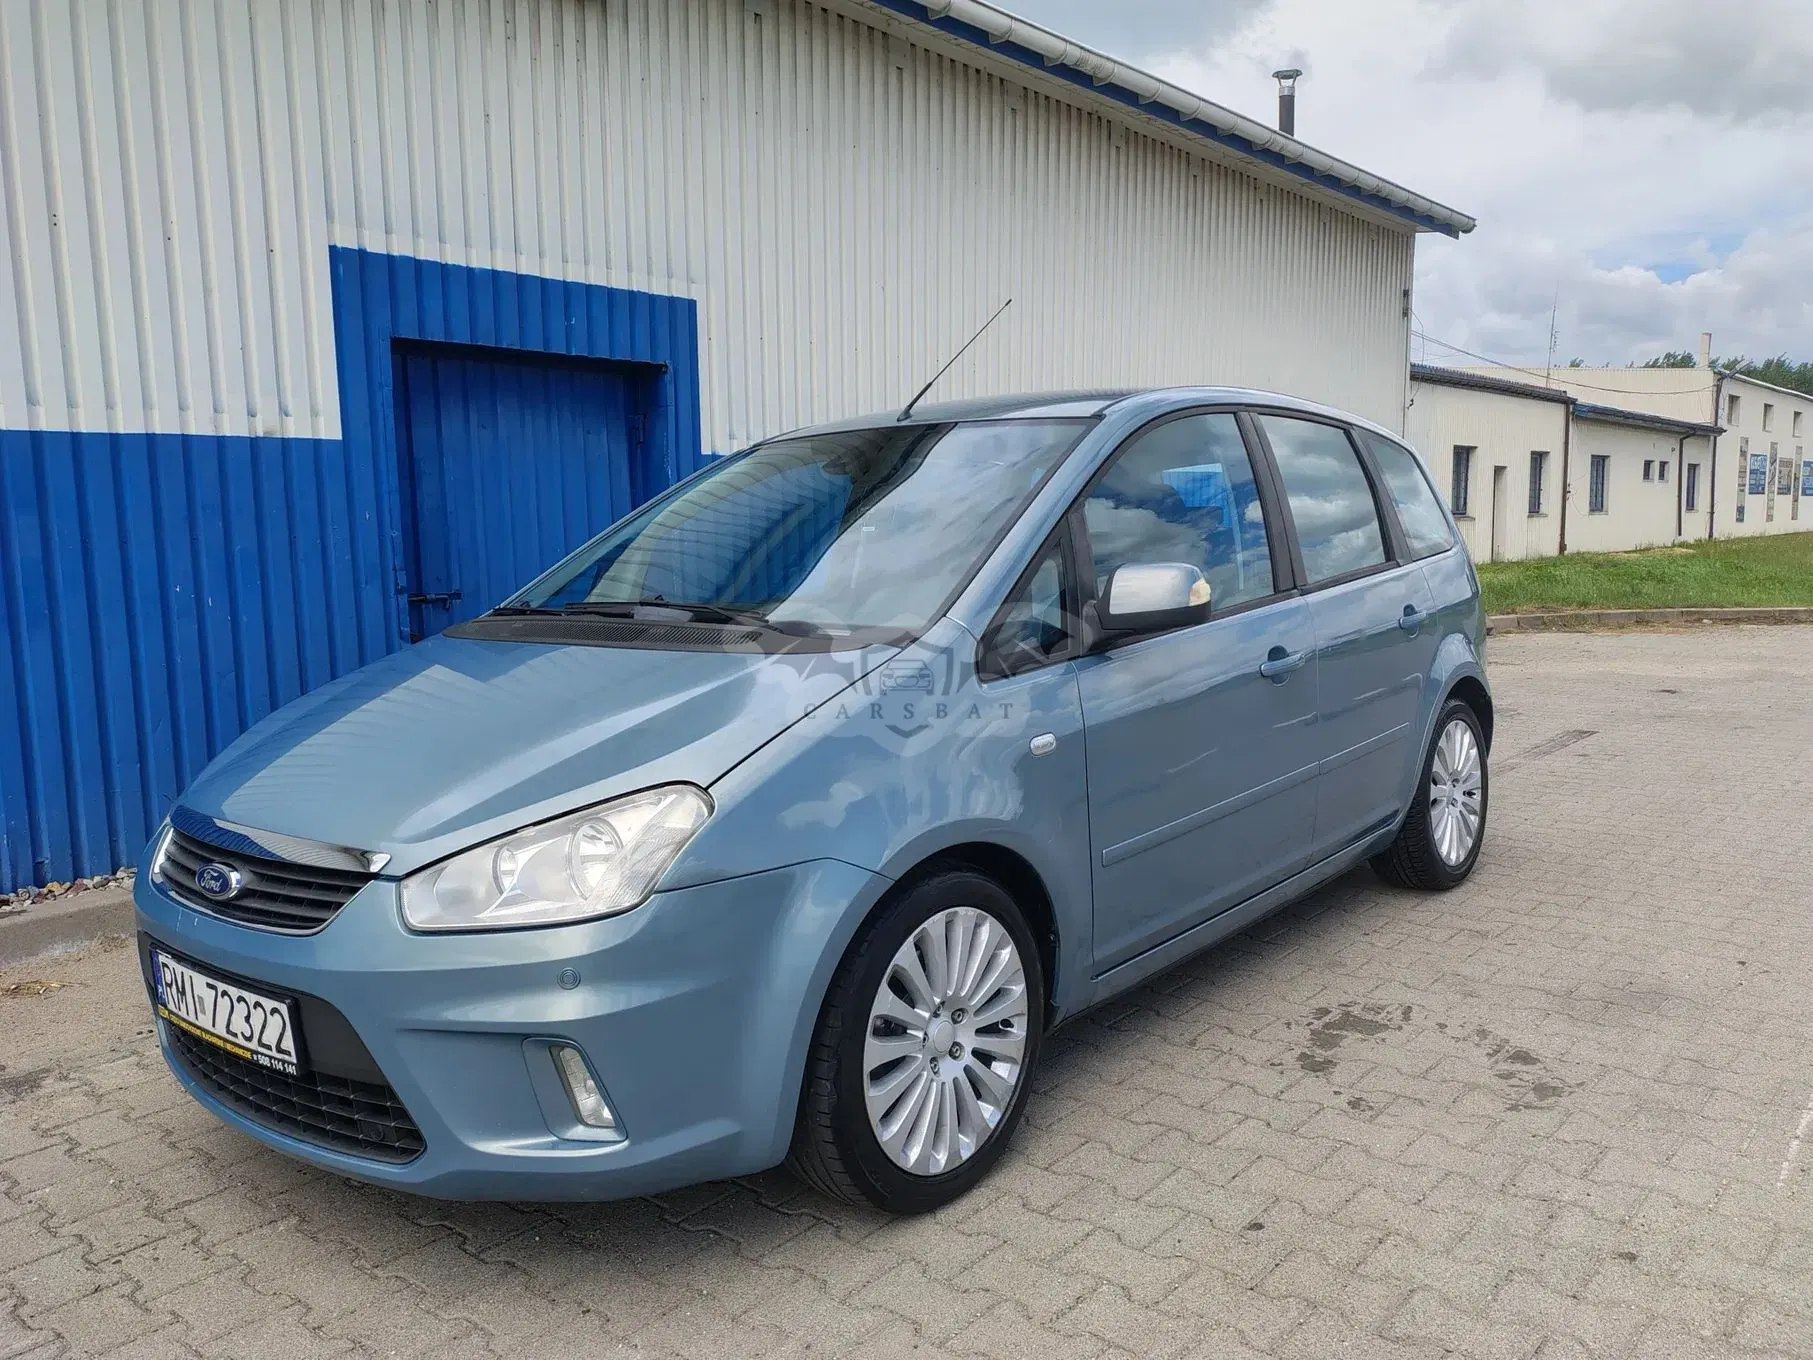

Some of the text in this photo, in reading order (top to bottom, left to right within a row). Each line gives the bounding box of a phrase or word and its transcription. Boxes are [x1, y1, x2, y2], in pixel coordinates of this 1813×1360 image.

[200, 869, 223, 892] Ford
[161, 961, 199, 1021] RMI
[205, 981, 292, 1058] 72322
[271, 1058, 284, 1071] 114
[285, 1063, 297, 1076] 141
